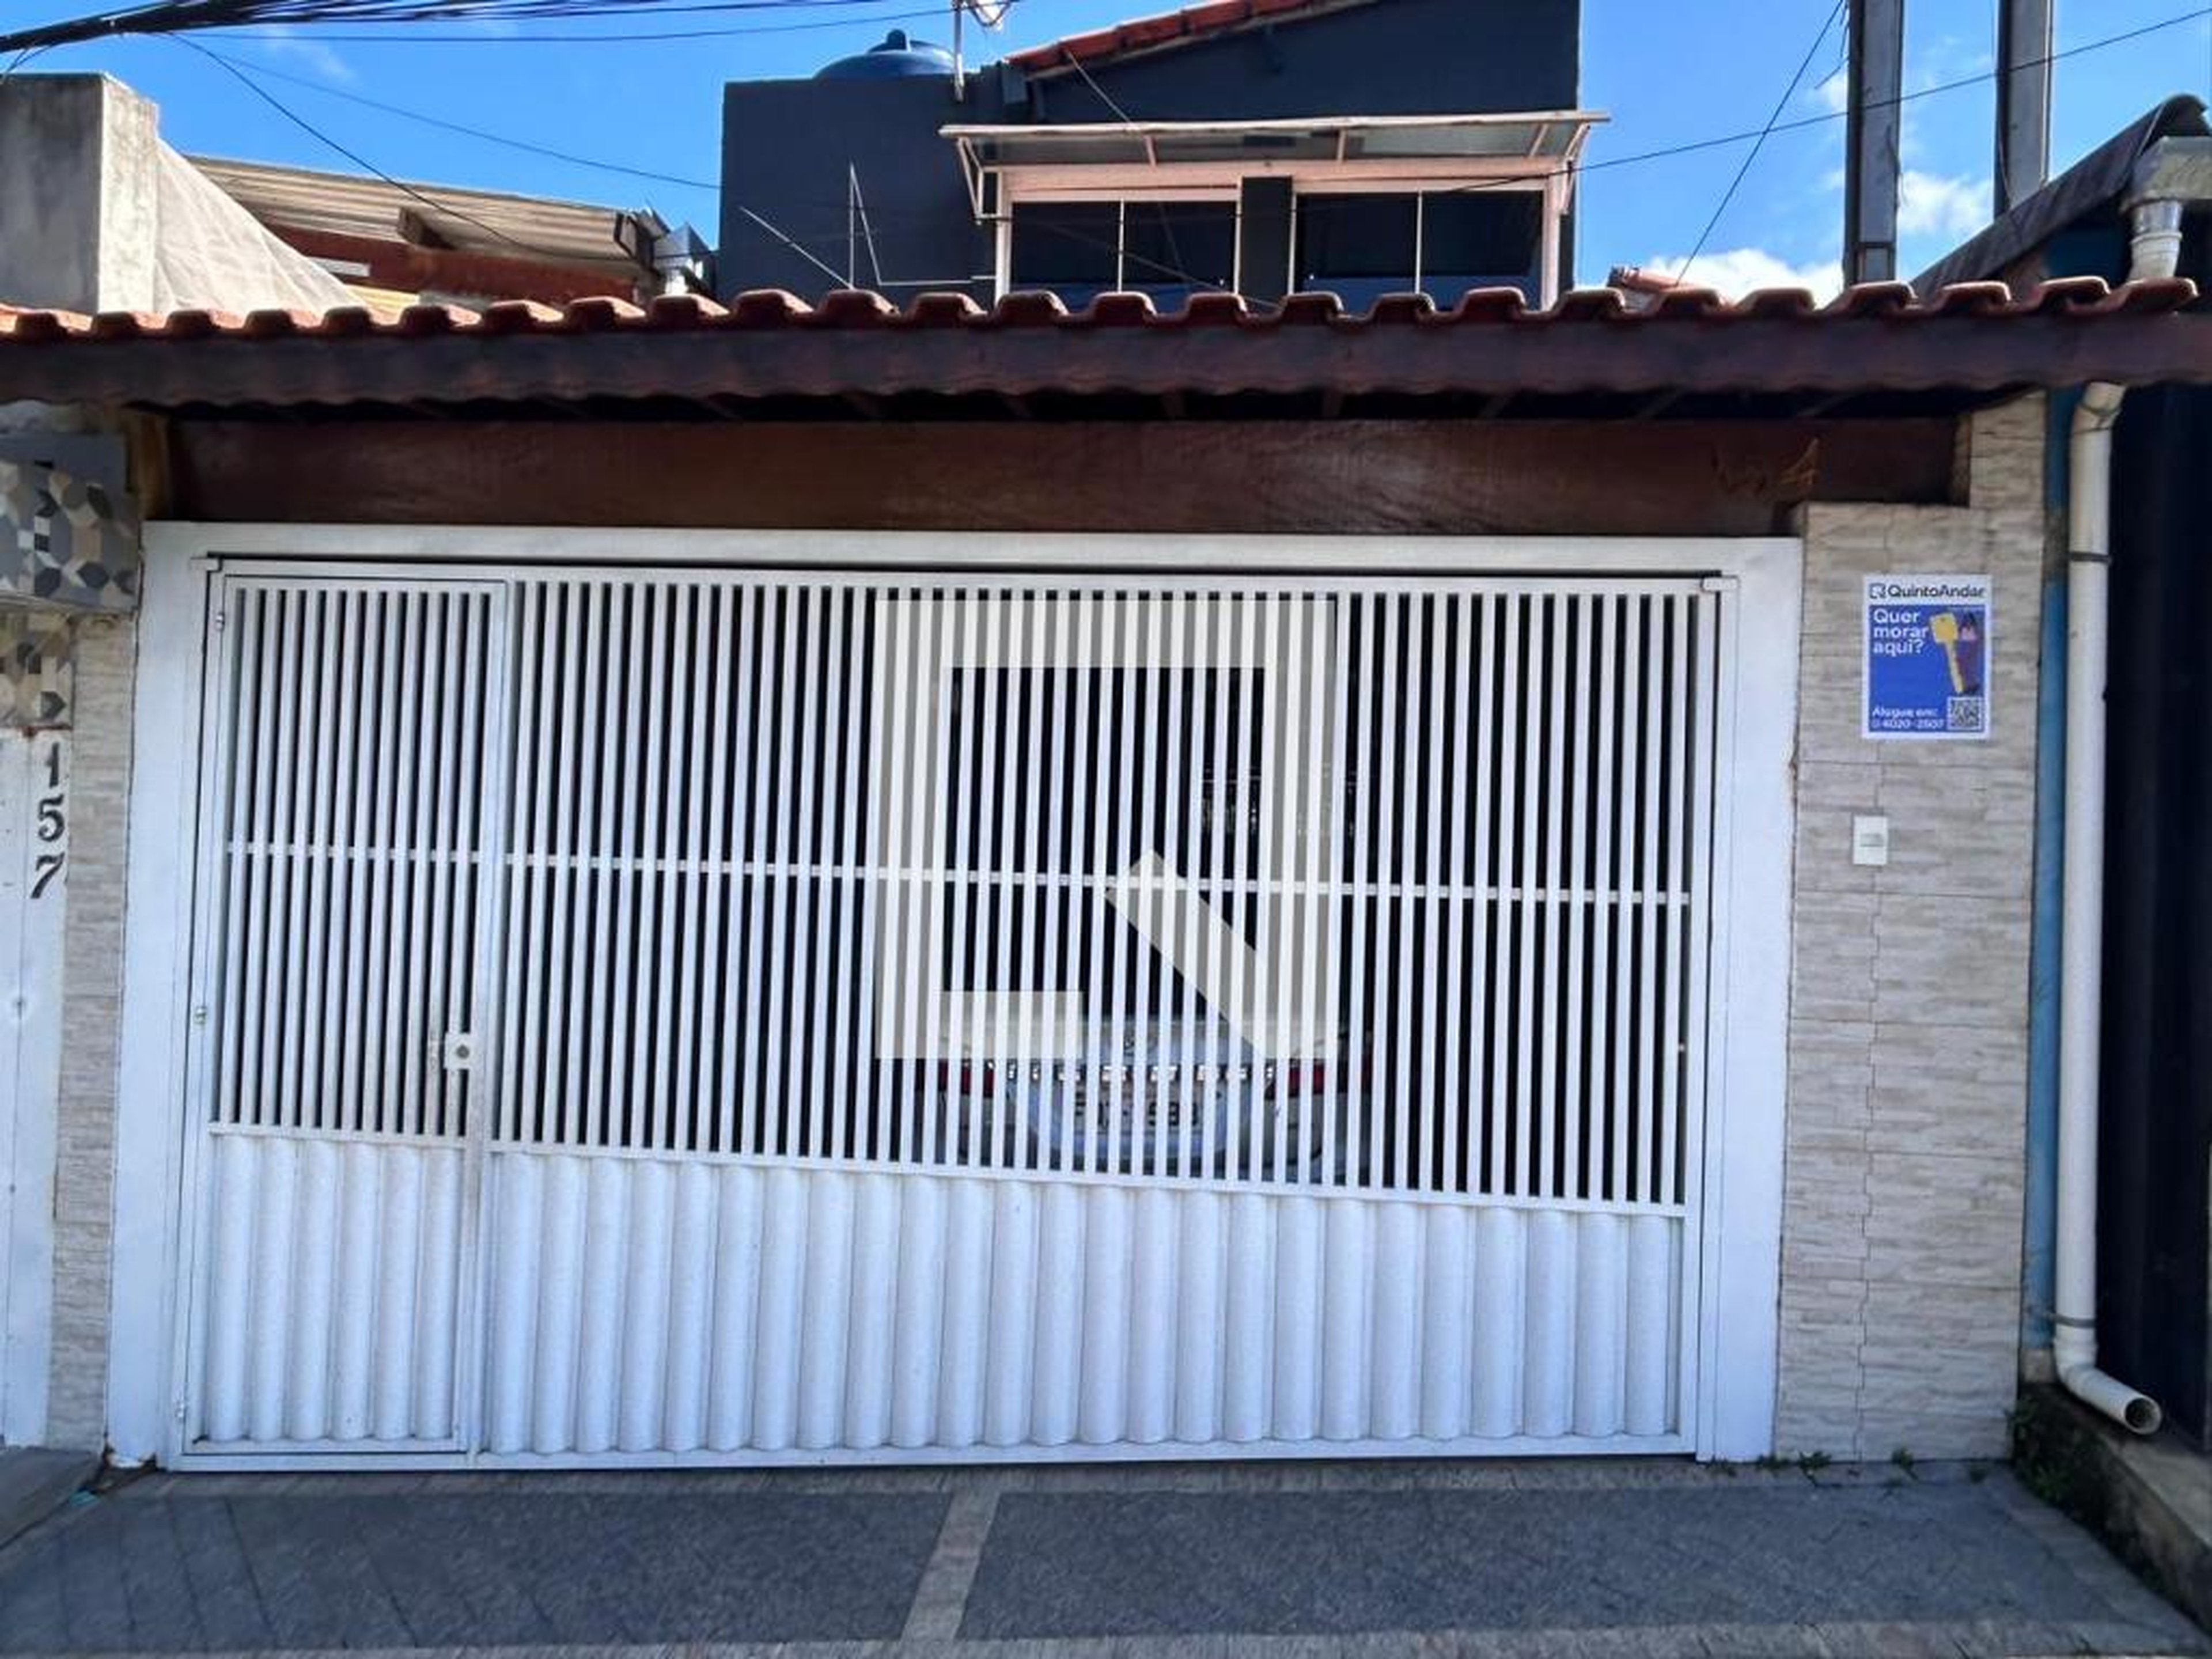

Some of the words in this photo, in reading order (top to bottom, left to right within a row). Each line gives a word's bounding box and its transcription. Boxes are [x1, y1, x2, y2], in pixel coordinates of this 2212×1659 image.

[1888, 584, 1985, 597] QuintoAndar
[1873, 608, 1921, 624] Quer
[1873, 626, 1929, 638] morar
[1873, 639, 1925, 657] aqui?
[31, 742, 65, 899] 157
